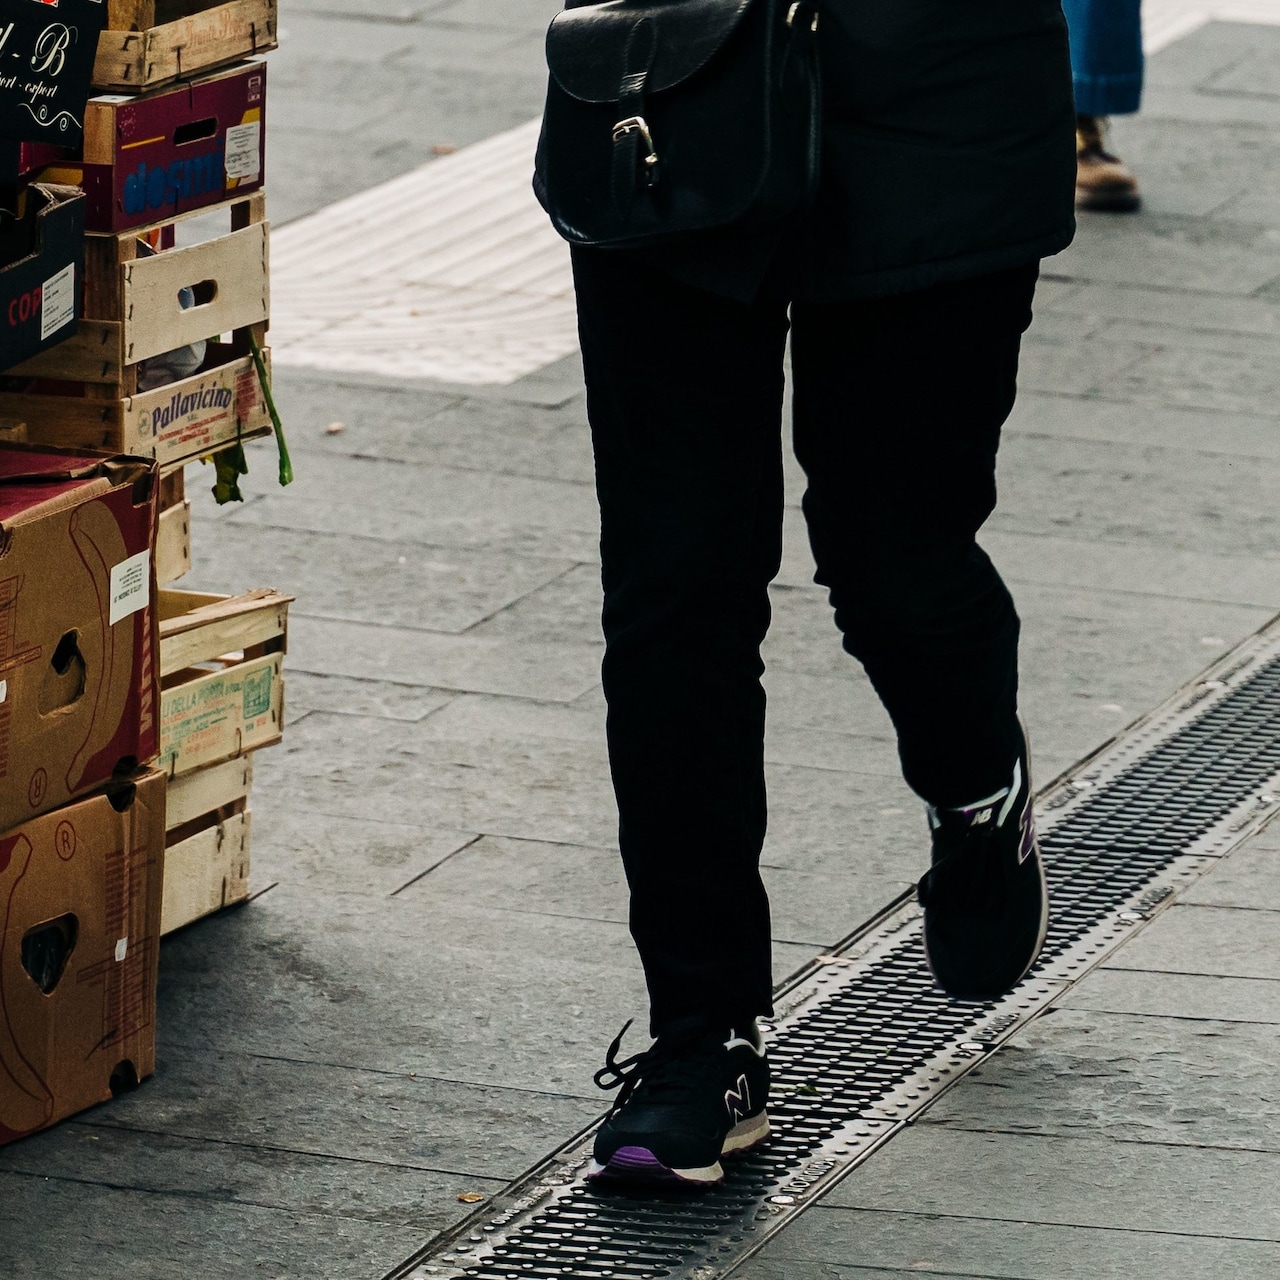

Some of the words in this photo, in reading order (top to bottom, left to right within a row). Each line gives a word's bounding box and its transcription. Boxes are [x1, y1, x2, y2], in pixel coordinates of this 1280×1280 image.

[30, 23, 78, 77] B
[24, 81, 58, 104] export
[151, 381, 232, 436] Pallavicino
